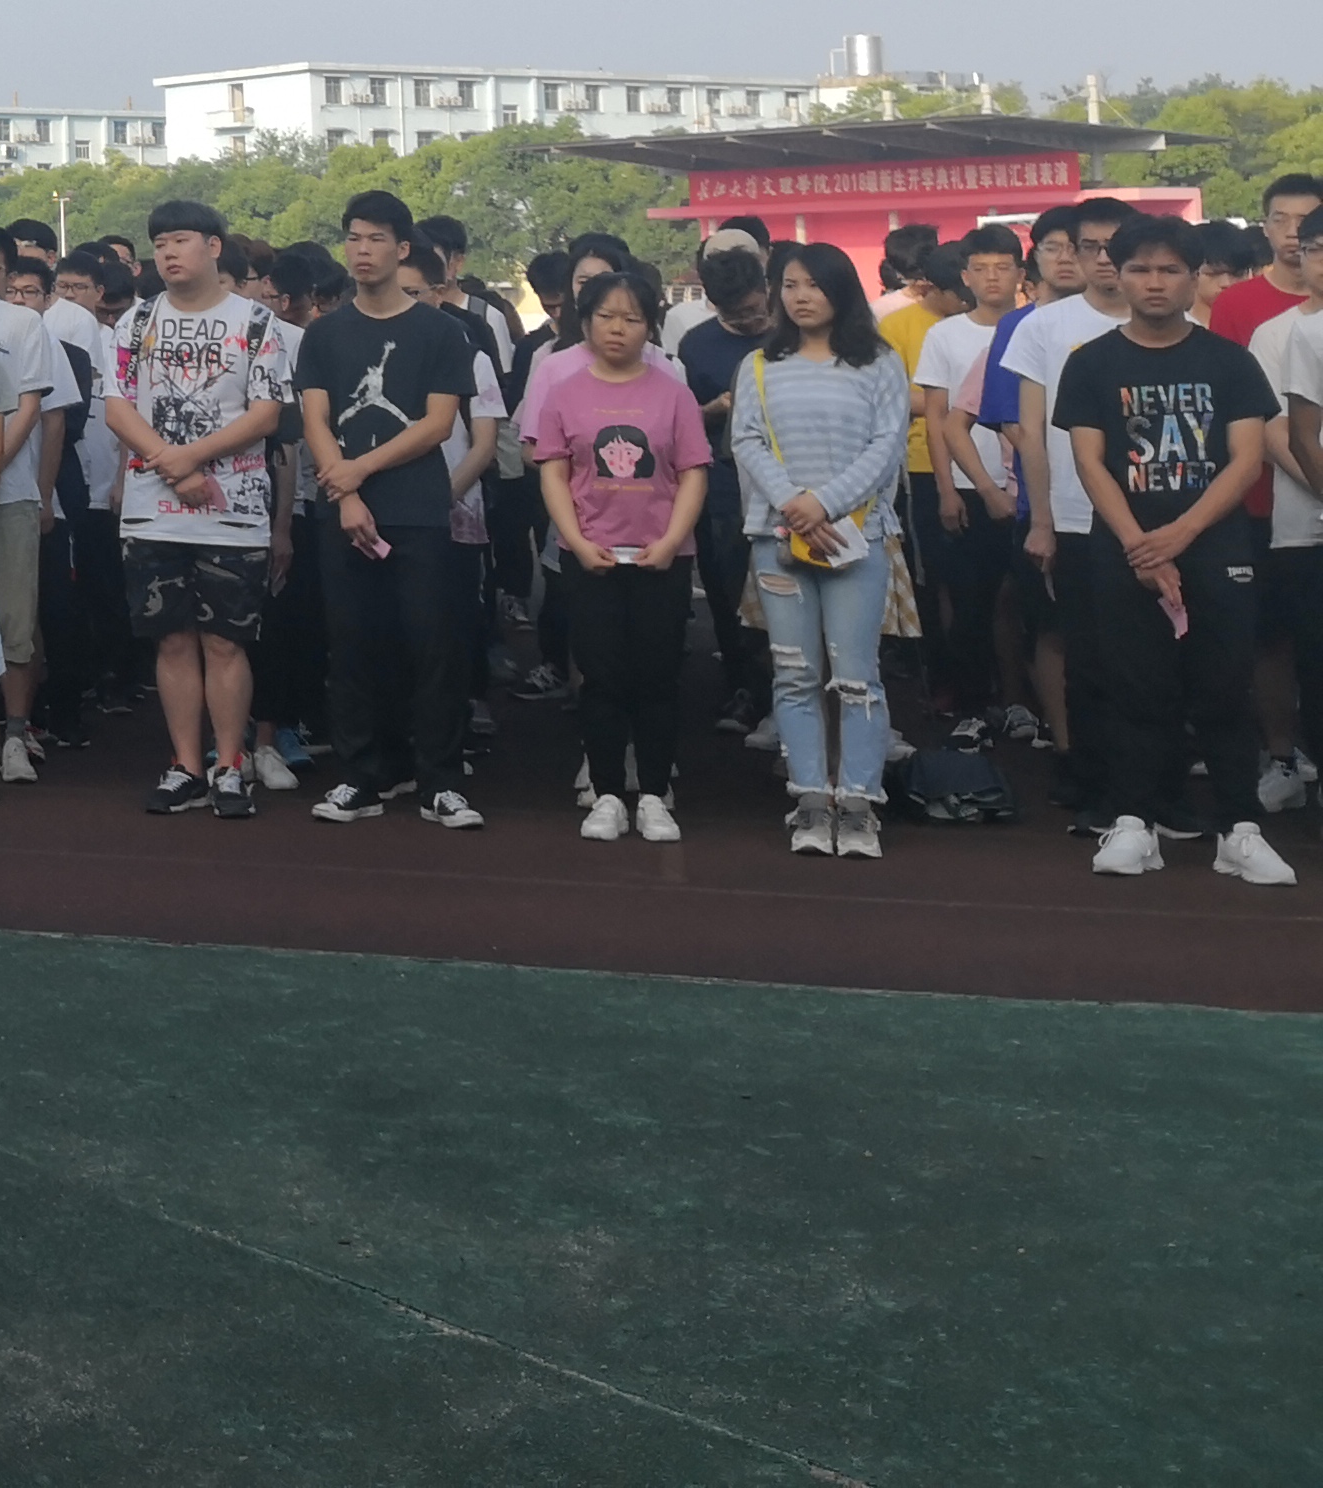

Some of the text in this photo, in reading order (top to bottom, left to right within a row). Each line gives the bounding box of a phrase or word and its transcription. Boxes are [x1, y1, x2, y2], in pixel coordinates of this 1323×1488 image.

[161, 318, 228, 341] DEAD
[1120, 382, 1214, 417] NEVER
[1126, 412, 1215, 464] SAY
[1128, 461, 1217, 492] NEVER
